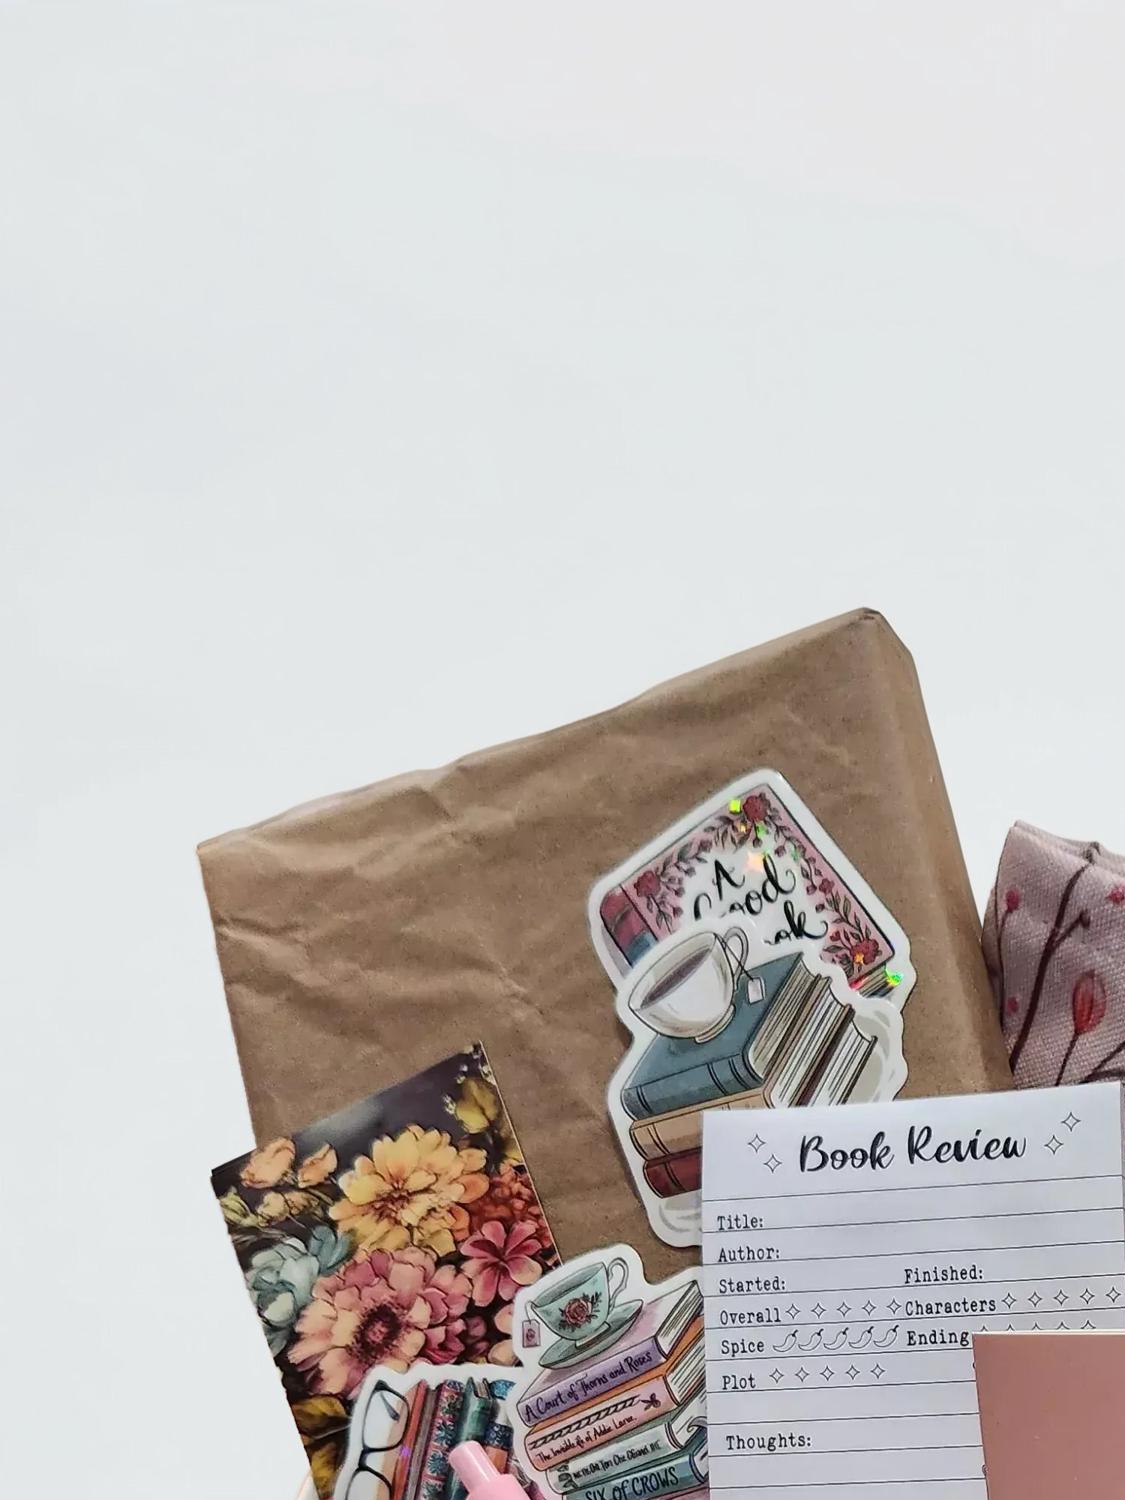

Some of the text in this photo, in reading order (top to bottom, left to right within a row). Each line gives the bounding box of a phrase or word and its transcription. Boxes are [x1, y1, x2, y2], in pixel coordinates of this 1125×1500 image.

[799, 1125, 1027, 1173] Book Review
[716, 1214, 764, 1231] Title:
[718, 1246, 780, 1262] Author:
[904, 1267, 983, 1284] Finished:
[719, 1277, 786, 1293] Started:
[905, 1297, 996, 1316] Characters
[720, 1308, 781, 1325] Overall
[906, 1329, 970, 1348] Ending
[721, 1340, 765, 1355] Spice
[525, 1351, 652, 1422] A Court of Thorns and Roses
[722, 1374, 756, 1390] Plot
[726, 1434, 811, 1452] Thoughts:
[632, 1466, 679, 1496] CROWS
